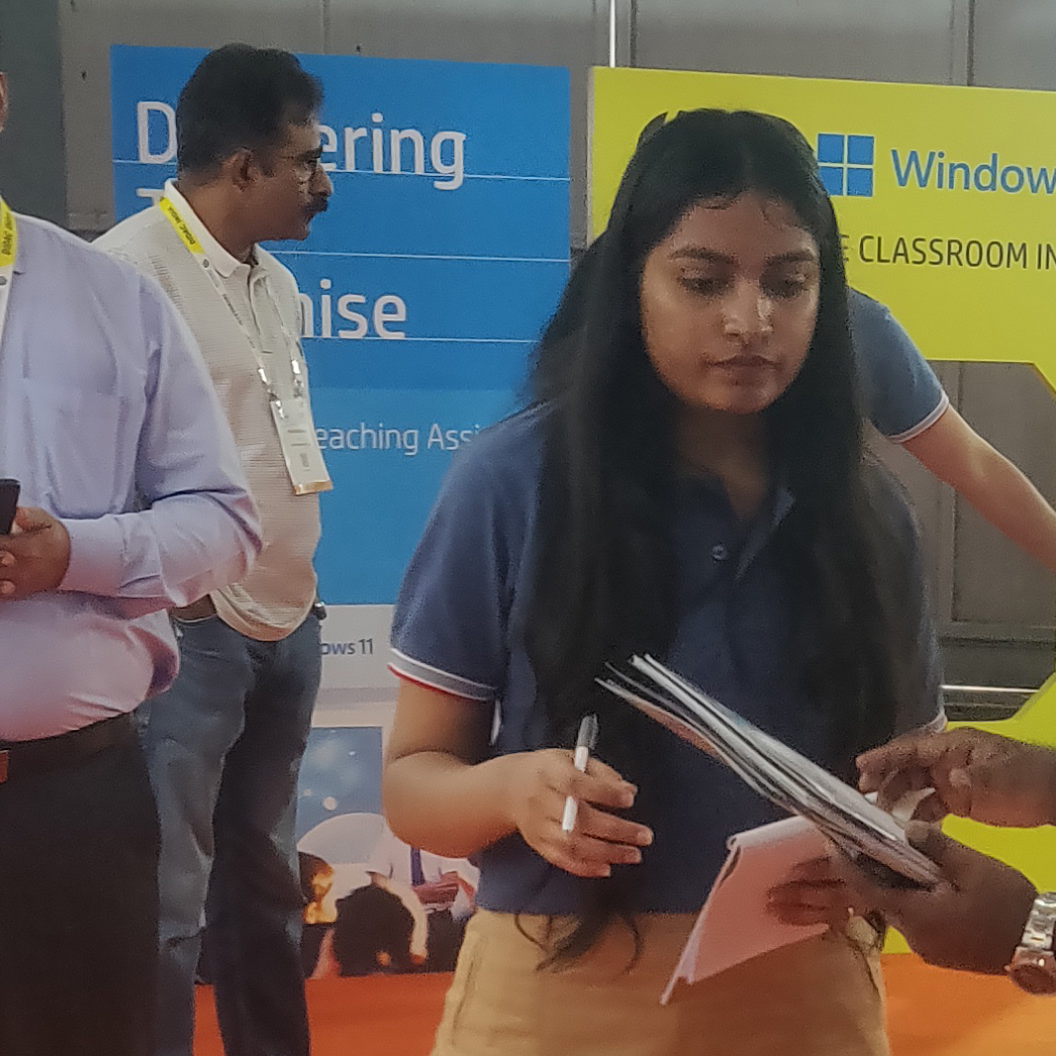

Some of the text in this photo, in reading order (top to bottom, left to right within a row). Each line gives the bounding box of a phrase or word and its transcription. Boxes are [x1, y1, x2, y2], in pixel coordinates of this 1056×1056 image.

[859, 235, 1028, 269] CLASSROOM
[316, 421, 419, 457] eaching
[358, 637, 374, 656] 11
